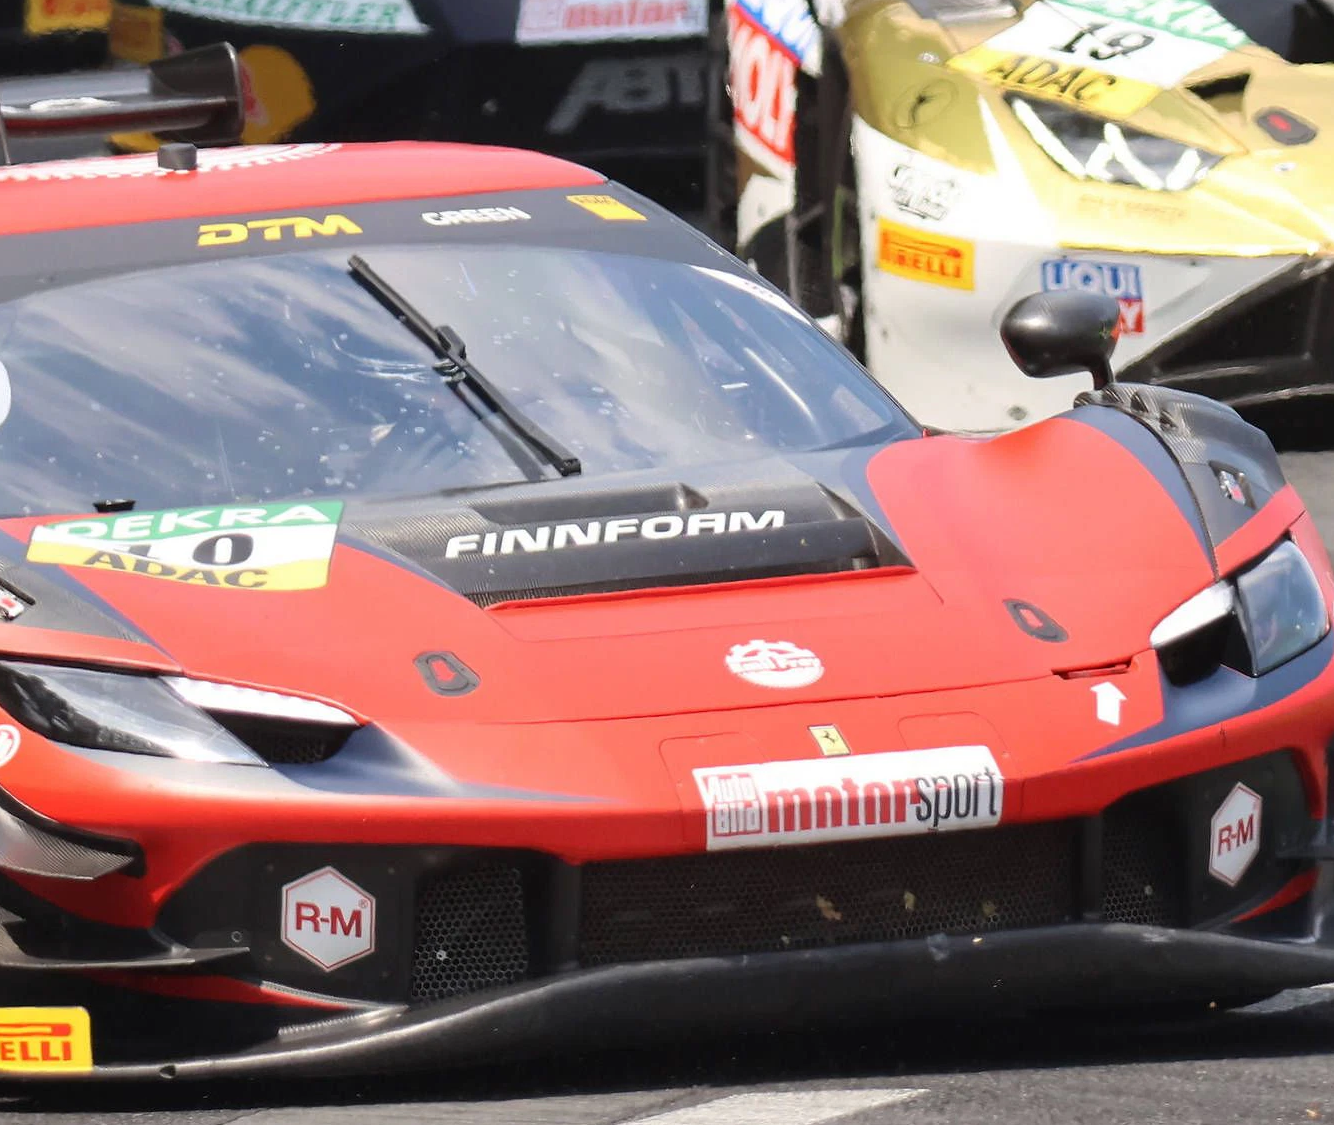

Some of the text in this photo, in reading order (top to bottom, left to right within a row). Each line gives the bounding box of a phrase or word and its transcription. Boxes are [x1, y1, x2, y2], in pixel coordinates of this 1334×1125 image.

[1050, 21, 1155, 61] 19
[987, 55, 1117, 101] ADAC
[196, 214, 363, 246] DTM
[421, 205, 531, 226] GREEN
[881, 226, 963, 280] PIRELLI
[64, 504, 331, 540] DEKRA
[83, 549, 269, 589] ADAC
[1216, 815, 1255, 856] R-M
[294, 901, 363, 939] R-M
